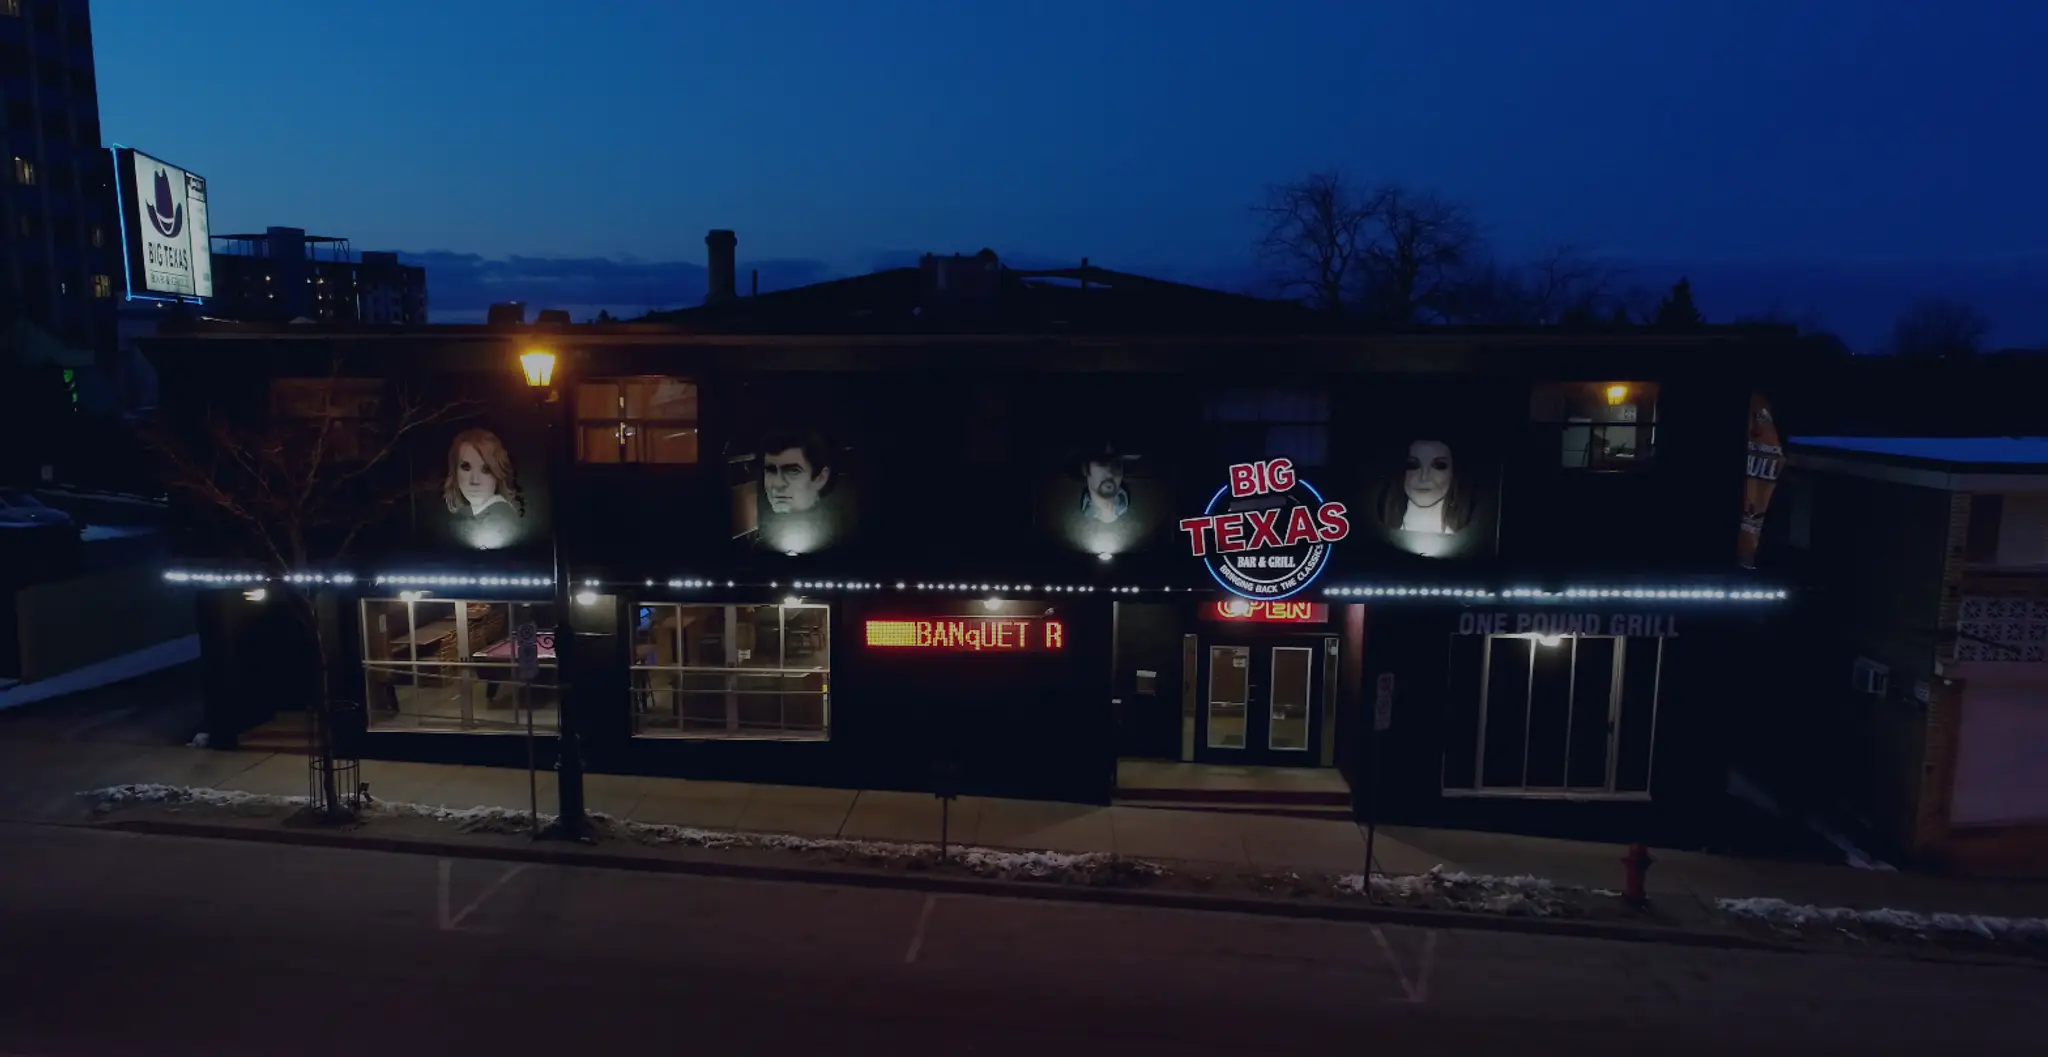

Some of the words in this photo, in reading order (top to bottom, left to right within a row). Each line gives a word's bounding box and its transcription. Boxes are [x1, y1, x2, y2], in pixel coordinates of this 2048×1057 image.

[148, 242, 163, 267] BIG
[164, 246, 188, 271] TEXAS
[1229, 457, 1296, 498] BIG
[1180, 502, 1350, 556] TEXAS
[1219, 564, 1254, 592] BRINGING
[1255, 584, 1278, 593] BACK
[1280, 577, 1297, 591] THE
[1296, 544, 1323, 582] CLASSICS
[1237, 556, 1255, 568] BAR
[1257, 556, 1267, 568] &
[1268, 556, 1296, 568] GRILL
[1046, 621, 1062, 648] R
[1459, 612, 1508, 635] ONE
[1516, 612, 1601, 636] POUND
[1609, 613, 1680, 637] GRILL
